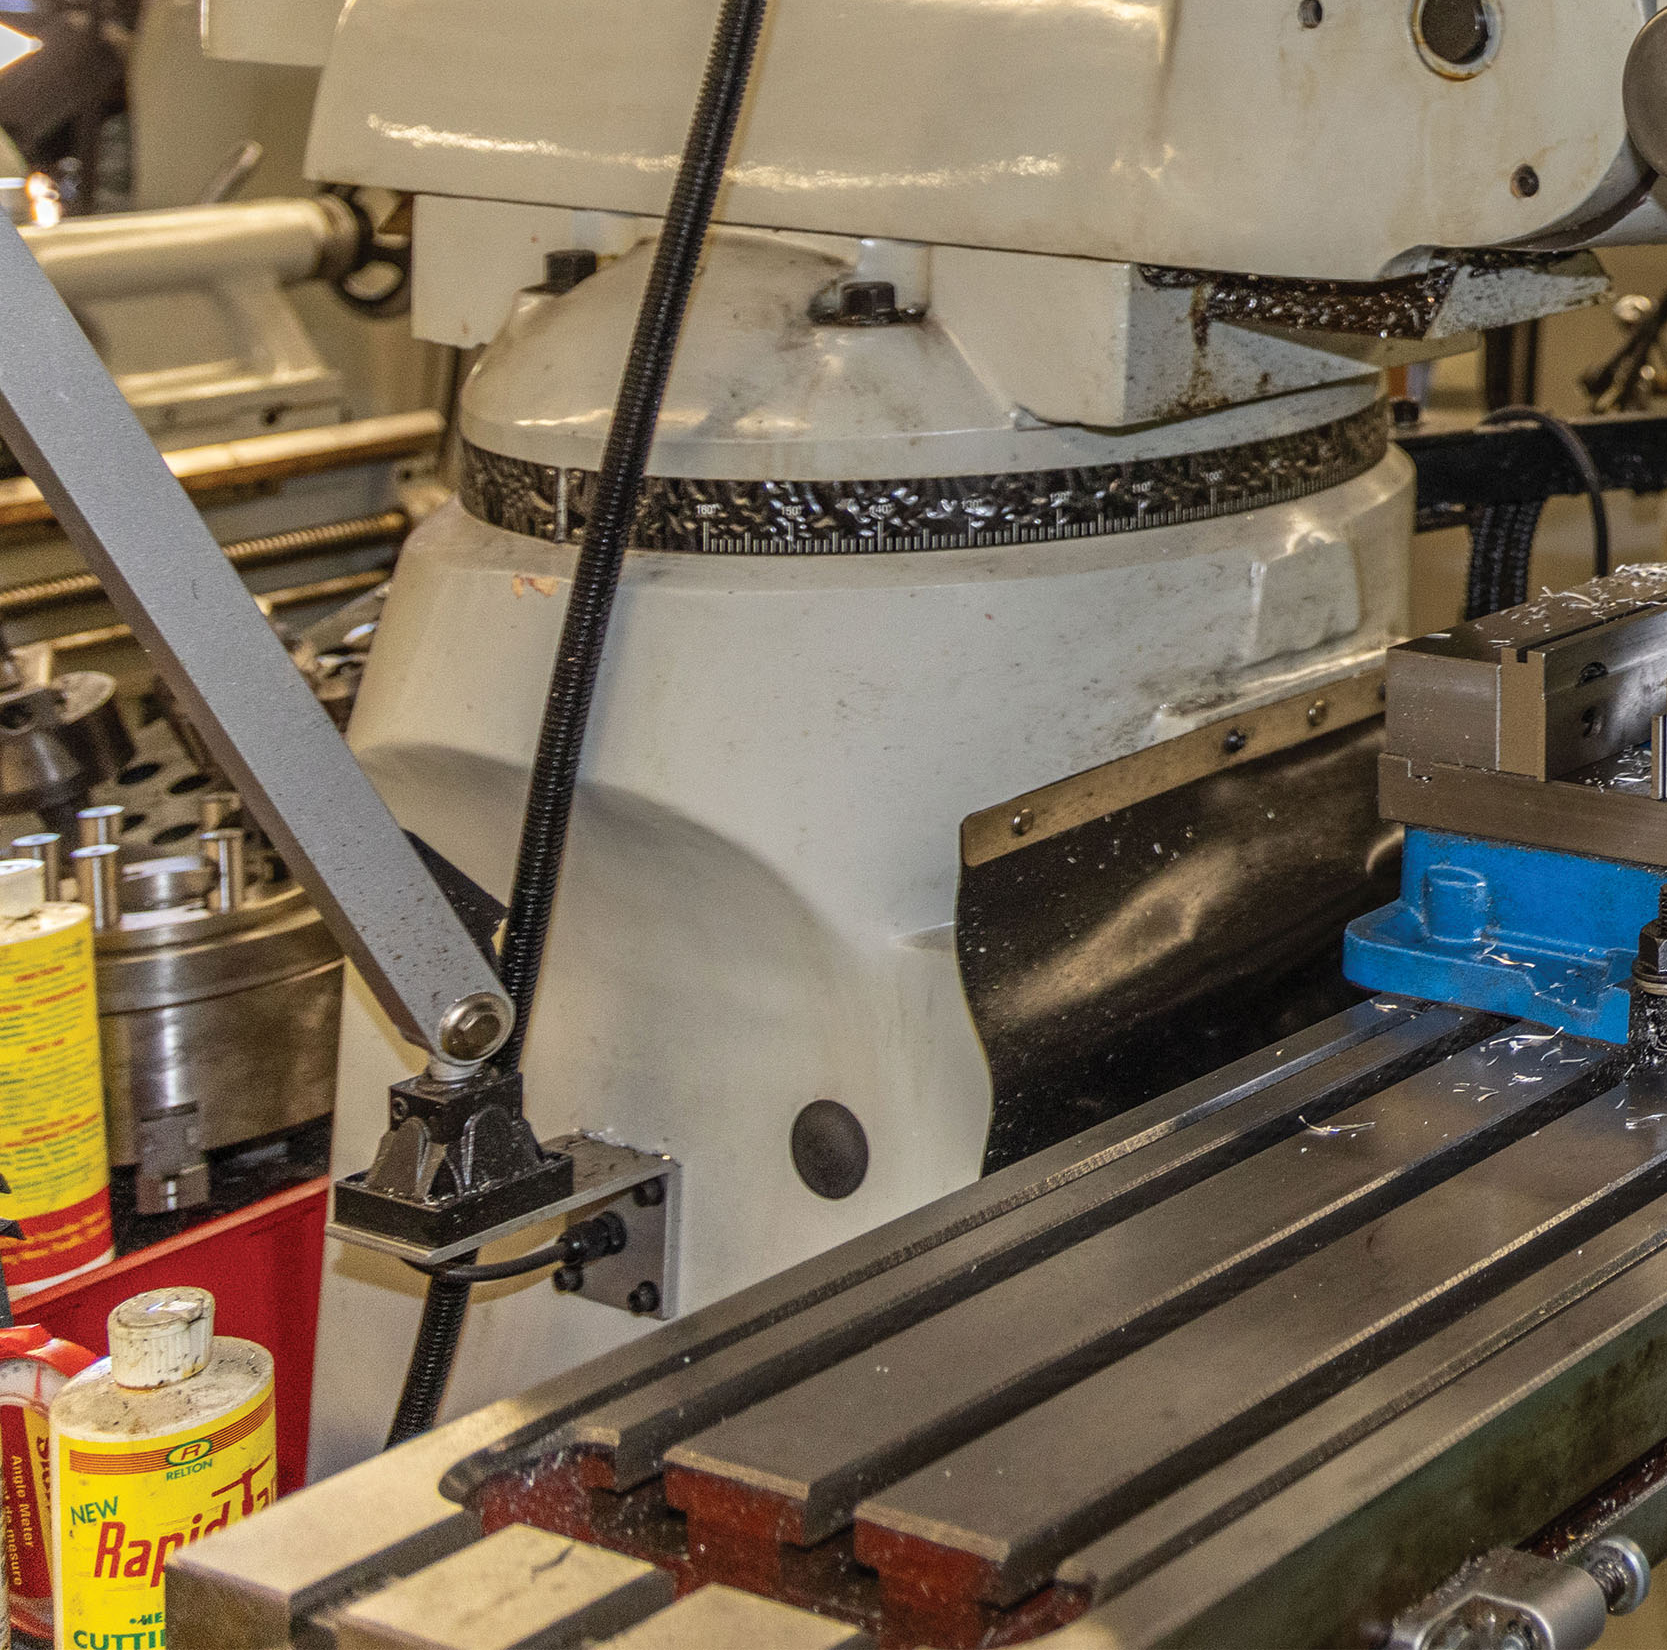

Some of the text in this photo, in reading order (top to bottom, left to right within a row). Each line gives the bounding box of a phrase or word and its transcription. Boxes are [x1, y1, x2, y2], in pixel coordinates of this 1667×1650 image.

[181, 1443, 201, 1461] R
[166, 1458, 213, 1481] RELTON
[10, 1454, 34, 1547] Angle Meter
[70, 1495, 119, 1526] NEW
[6, 1528, 23, 1587] mesure
